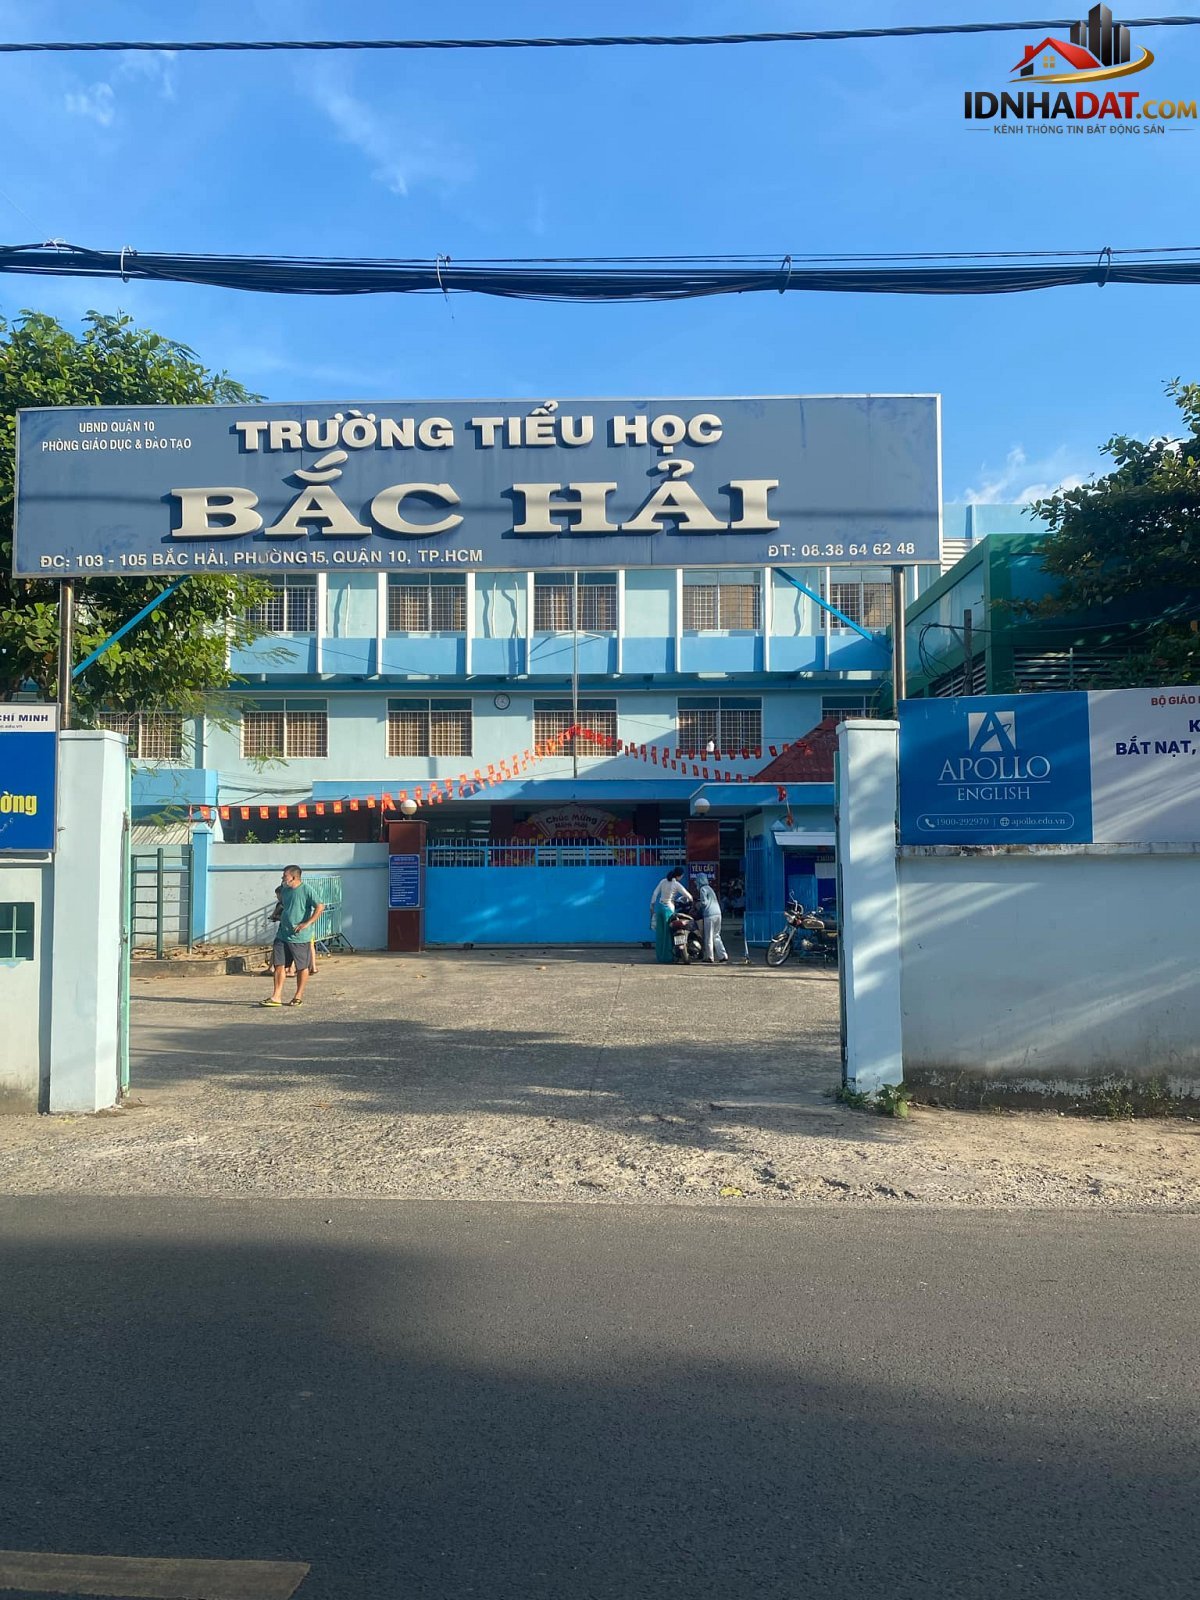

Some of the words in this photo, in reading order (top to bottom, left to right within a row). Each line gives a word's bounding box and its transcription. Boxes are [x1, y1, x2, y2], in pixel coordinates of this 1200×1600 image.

[79, 422, 108, 433] UBND
[111, 419, 141, 434] QUẬN
[144, 421, 155, 432] 10
[234, 410, 455, 451] TRƯỜNG
[470, 400, 594, 447] TIỂU
[612, 413, 723, 454] HỌC
[42, 439, 79, 451] PHÒNG
[82, 437, 108, 450] GIÁO
[110, 439, 132, 451] DỤC
[135, 439, 142, 449] &
[145, 437, 168, 449] ĐÀO
[170, 438, 192, 450] TẠO
[169, 450, 465, 537] BẮC
[511, 458, 780, 533] HẢI
[768, 544, 796, 557] ĐT:
[801, 544, 844, 556] 08.38
[849, 543, 867, 556] 64
[873, 543, 891, 555] 62
[896, 542, 915, 554] 48
[40, 555, 70, 568] ĐC:
[76, 555, 103, 567] 103
[119, 553, 147, 566] 105
[152, 548, 188, 565] BẮC
[194, 548, 228, 566] HẢI,
[310, 551, 329, 564] 15,
[333, 549, 382, 565] QUẬN
[389, 550, 411, 564] 10,
[418, 549, 483, 562] TP.HCM
[1151, 695, 1166, 708] BỘ
[1168, 694, 1196, 705] GIÁO
[0, 713, 15, 721] HÍ
[1115, 735, 1151, 755] BẮT
[1154, 740, 1197, 757] NẠT,
[938, 755, 1051, 781] APOLLO
[957, 786, 1031, 801] ENGLISH
[1011, 816, 1066, 827] apollo.edu.vn
